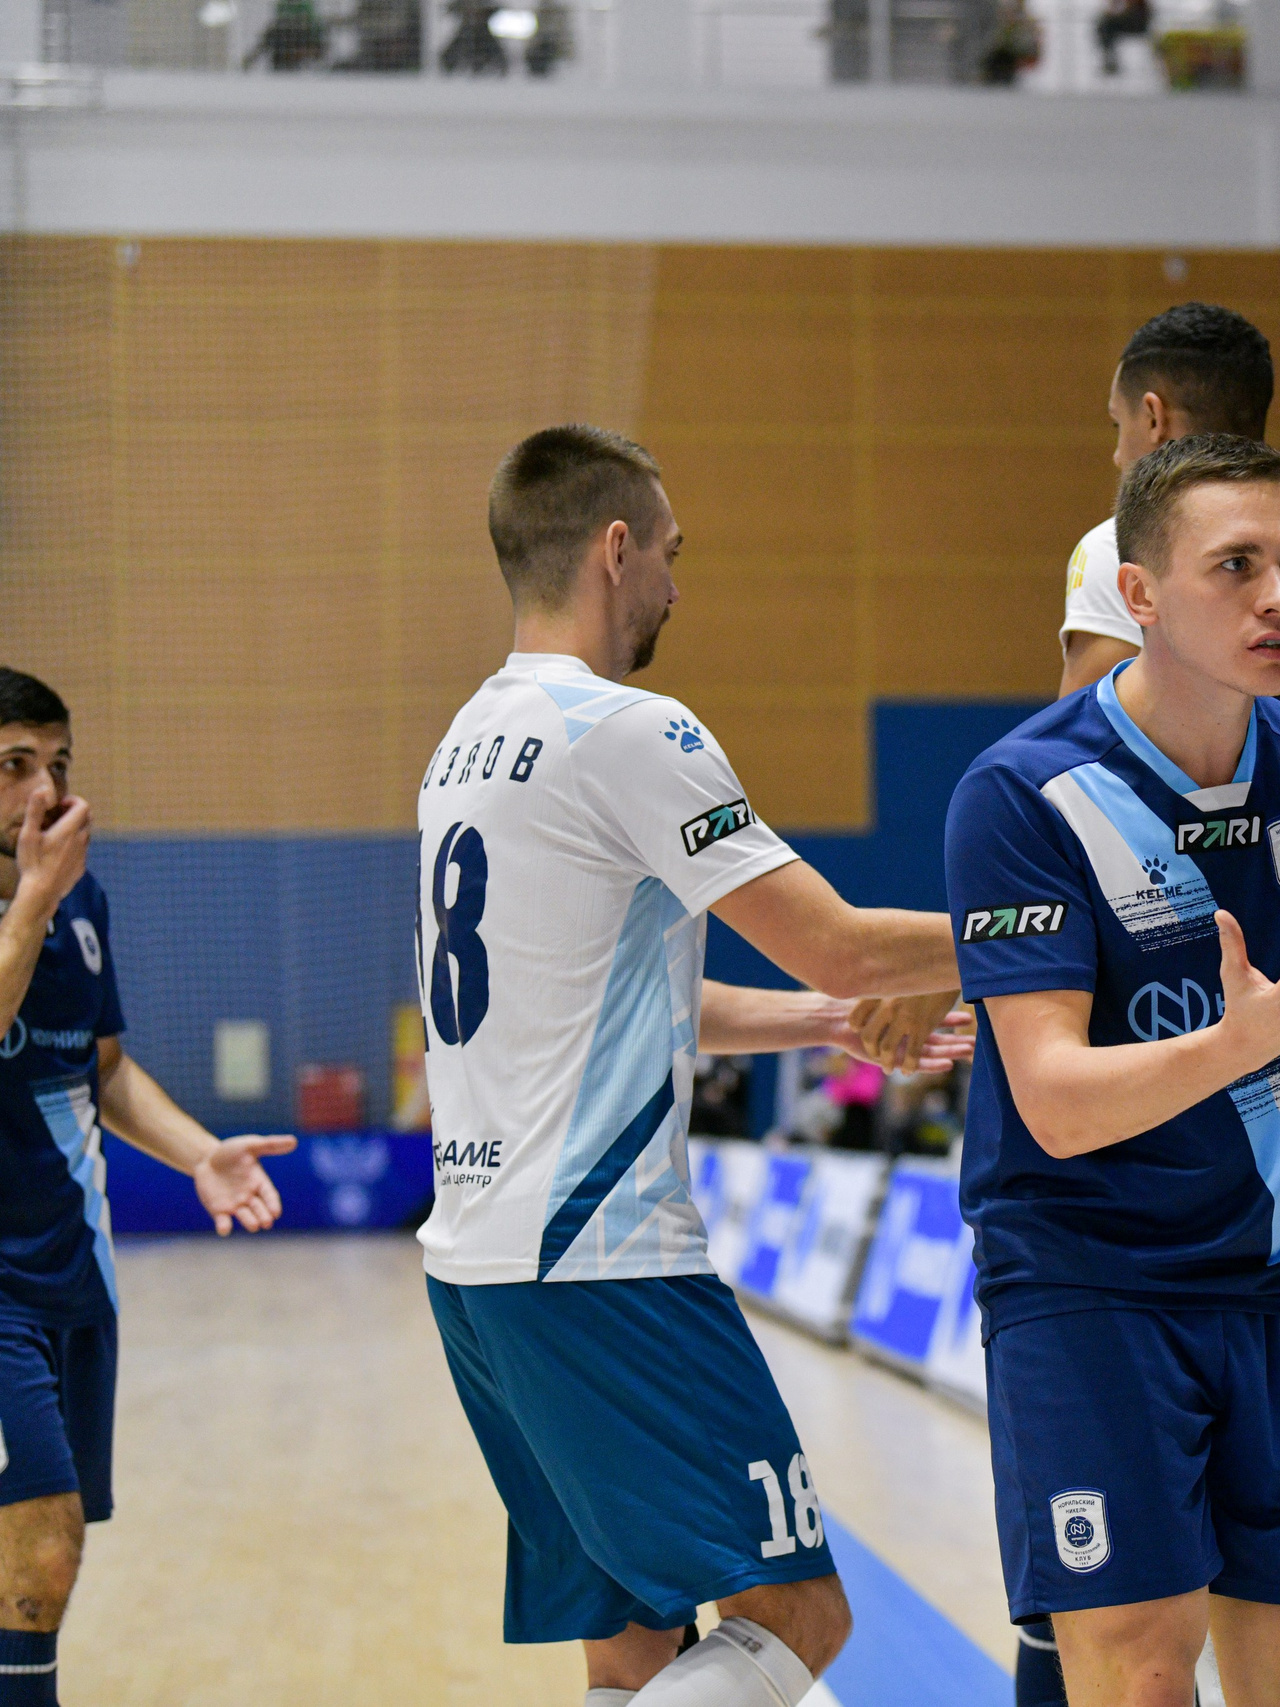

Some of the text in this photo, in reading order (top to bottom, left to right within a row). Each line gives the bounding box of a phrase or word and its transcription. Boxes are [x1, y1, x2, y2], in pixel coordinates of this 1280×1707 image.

[424, 735, 543, 789] ОЗЛОВ
[1178, 816, 1261, 850] PARI
[1136, 886, 1183, 900] KELME
[964, 904, 1064, 940] PARI
[453, 1173, 492, 1188] центр
[748, 1452, 824, 1558] 18
[1057, 1499, 1096, 1510] НОРИЛЬСКИЙ
